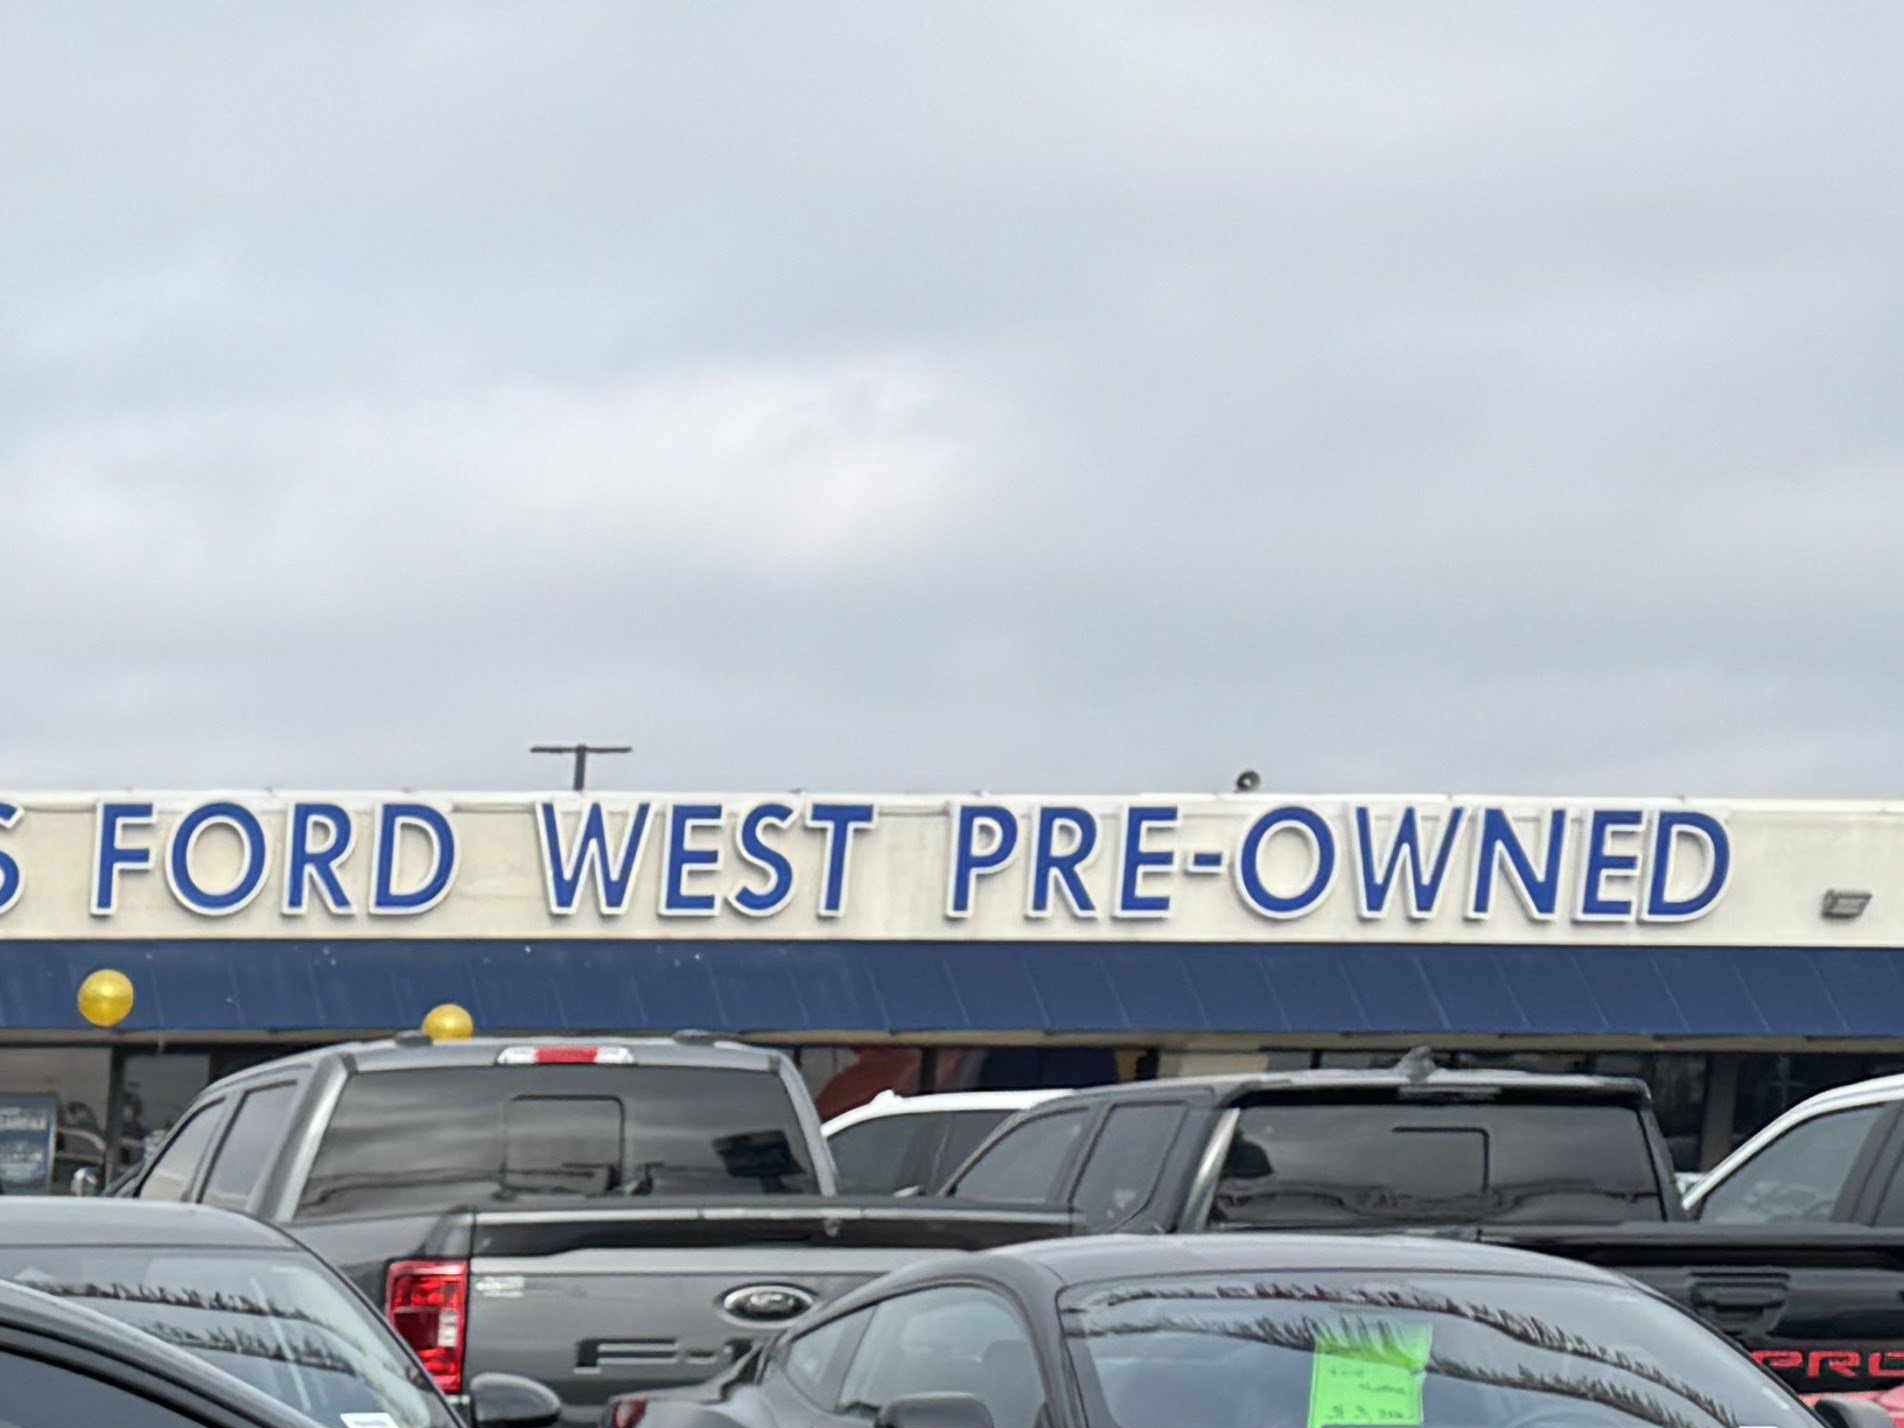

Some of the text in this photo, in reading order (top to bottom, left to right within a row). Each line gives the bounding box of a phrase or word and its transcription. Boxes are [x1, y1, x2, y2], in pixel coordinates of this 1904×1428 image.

[91, 799, 459, 919] FORD
[535, 800, 876, 918] WEST
[947, 803, 1734, 925] PRE-OWNED
